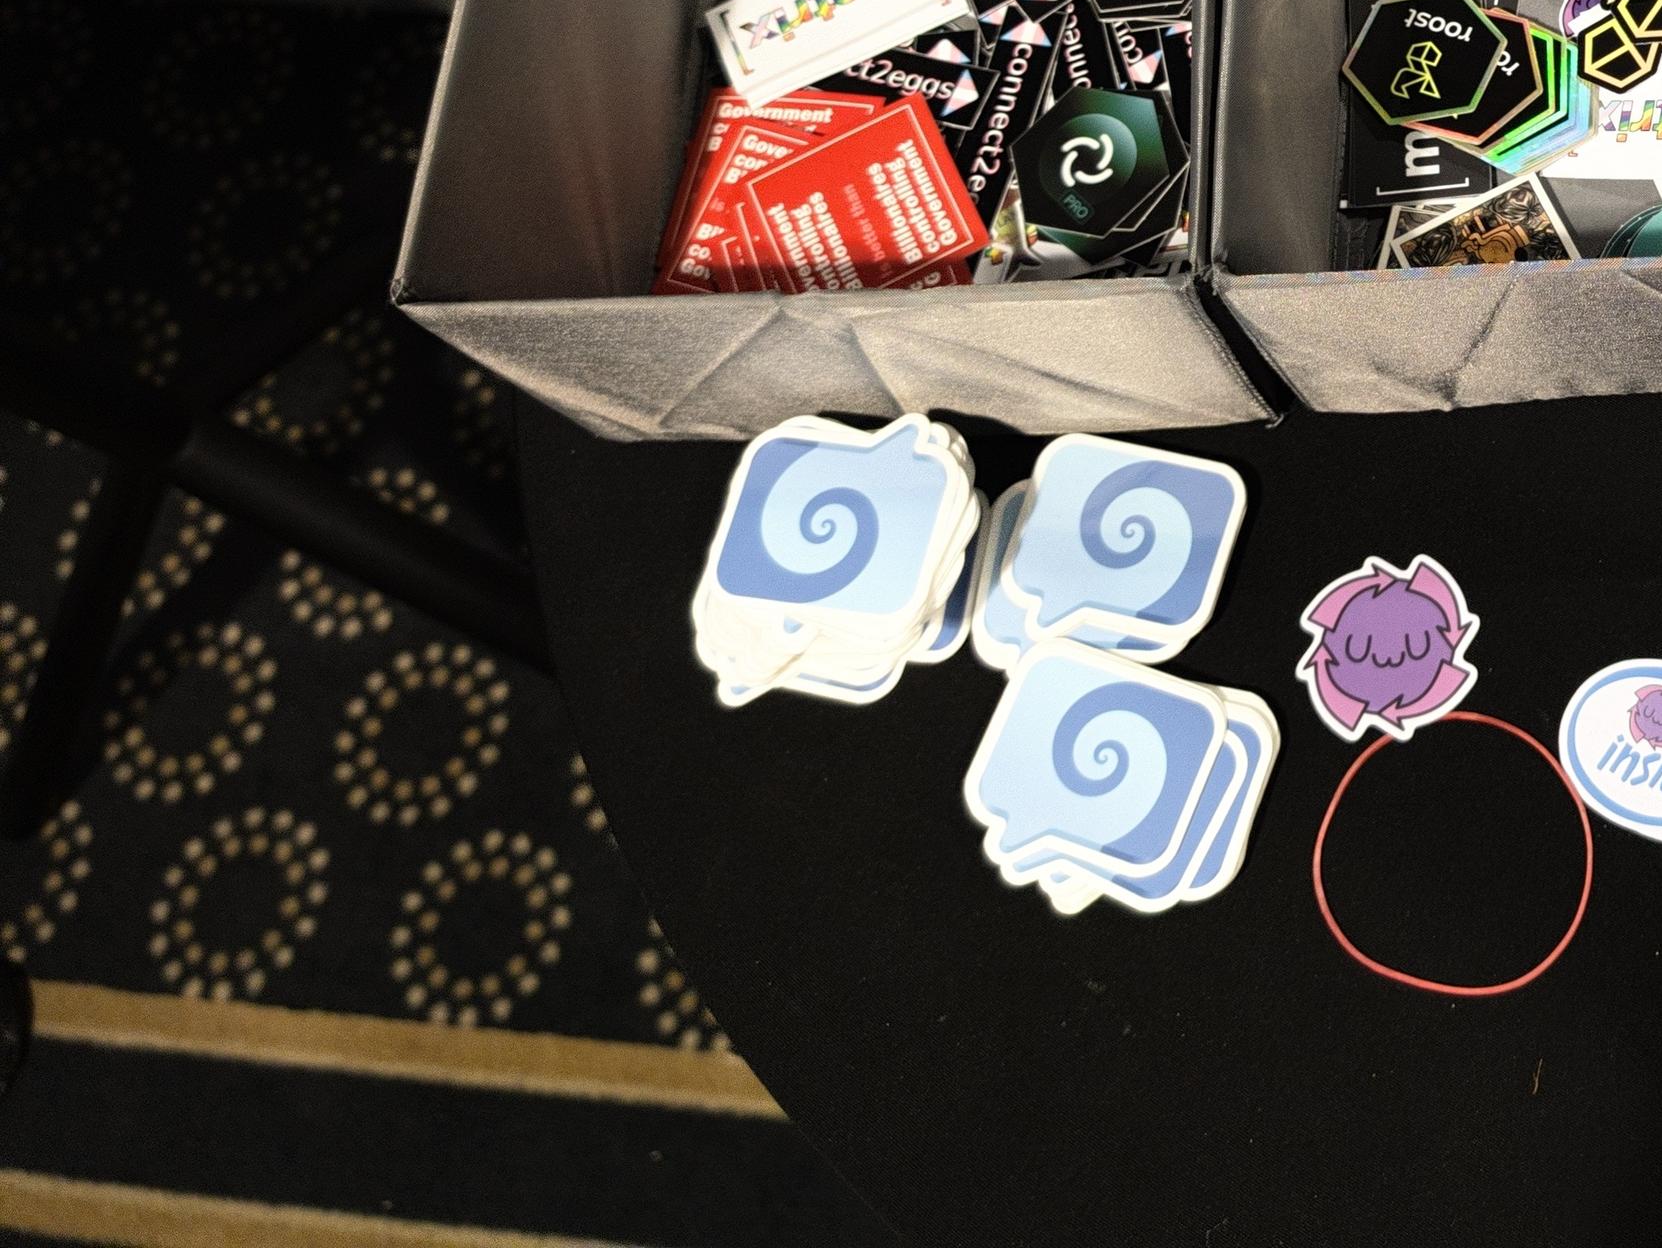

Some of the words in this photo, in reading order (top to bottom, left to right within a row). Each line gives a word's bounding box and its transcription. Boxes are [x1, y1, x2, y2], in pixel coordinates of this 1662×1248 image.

[1404, 7, 1473, 44] roost
[867, 162, 923, 264] Billionaires
[884, 157, 941, 253] controlling
[895, 141, 958, 246] Government
[1063, 194, 1089, 219] PRO
